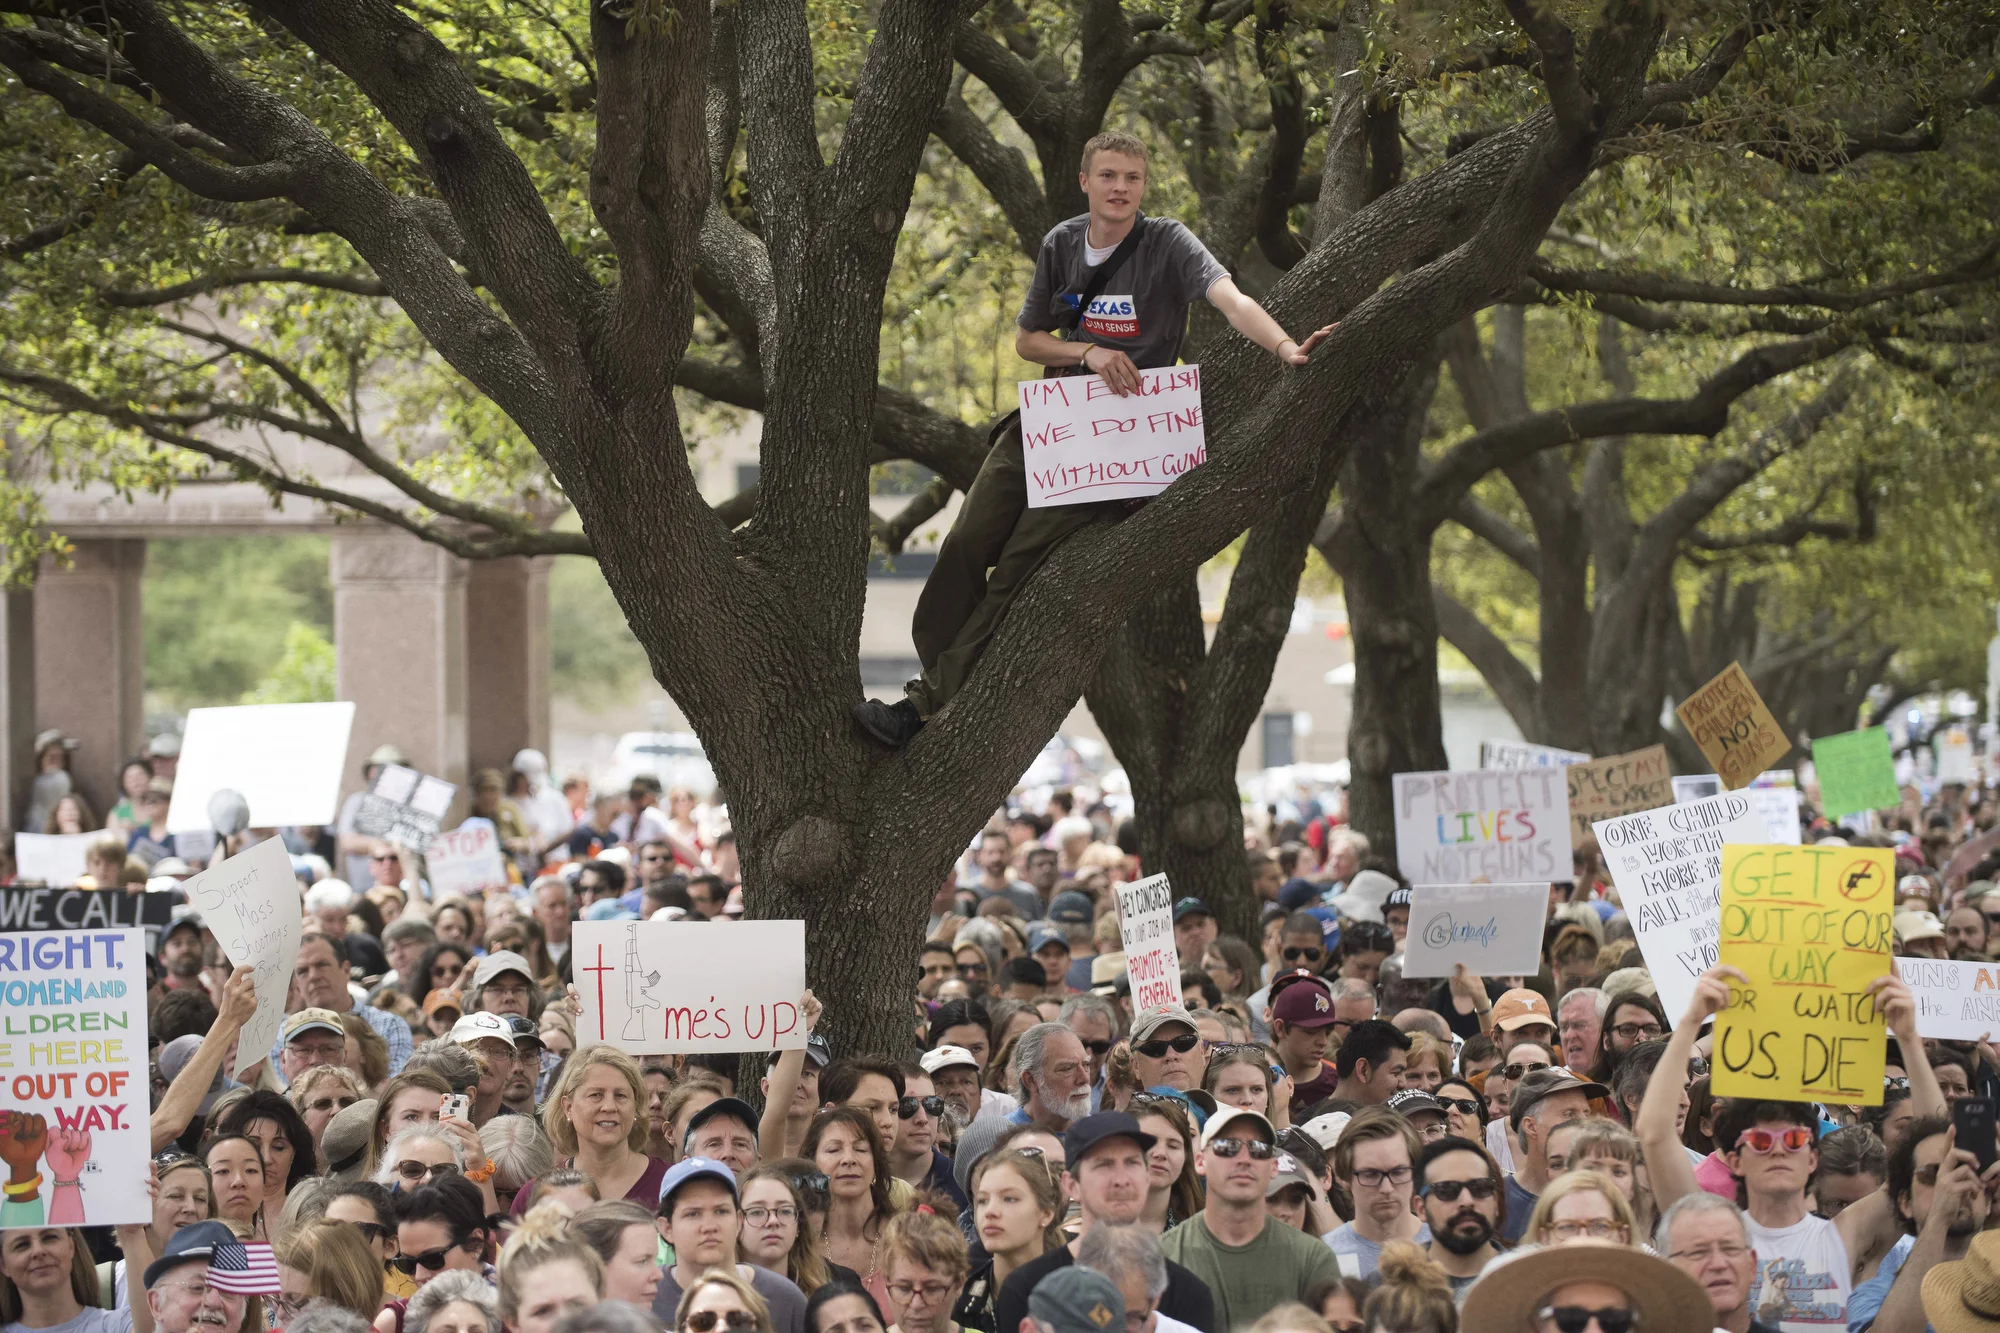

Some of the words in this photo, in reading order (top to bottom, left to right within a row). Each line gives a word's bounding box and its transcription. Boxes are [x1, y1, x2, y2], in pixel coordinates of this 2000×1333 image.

[1085, 318, 1105, 331] GUN
[1105, 322, 1137, 333] SENSE
[1089, 301, 1133, 316] EXAS
[1023, 380, 1070, 410] I'M
[1026, 422, 1076, 450] WE
[1091, 418, 1137, 437] DO
[1147, 405, 1203, 434] FINE
[1033, 456, 1159, 490] WITHOUT
[1683, 667, 1744, 725] PROTECT
[1695, 687, 1757, 745] CHILDREN
[1718, 712, 1758, 751] NOT
[1719, 721, 1775, 775] GUNS
[1635, 753, 1663, 780] MY
[1401, 768, 1558, 819] PROTECT
[1437, 810, 1536, 845] LIVES
[1605, 815, 1658, 848] ONE
[1669, 795, 1748, 833] CHILD
[427, 827, 489, 860] STOP
[1623, 855, 1640, 873] is
[1641, 829, 1724, 865] WORTH
[197, 867, 259, 911] Support
[1641, 861, 1704, 896] MORE
[1730, 849, 1836, 899] GET
[0, 888, 51, 930] WE
[55, 889, 163, 934] CALL
[234, 899, 274, 930] Mass
[1120, 890, 1136, 919] HEY
[1135, 878, 1172, 915] CONGRESS
[1639, 896, 1690, 932] ALL
[231, 923, 289, 962] Shootings
[1124, 929, 1132, 945] DO
[1148, 919, 1160, 938] JOB
[1161, 915, 1171, 934] AND
[1722, 904, 1795, 945] OUT
[1802, 909, 1840, 944] OF
[1841, 909, 1893, 952] OUR
[0, 934, 125, 972] RIGHT,
[1769, 948, 1837, 983] WAY
[0, 978, 83, 1007] OMEN
[84, 980, 127, 999] AND
[1139, 977, 1177, 1010] GENERAL
[1901, 963, 1961, 991] UNS
[1727, 988, 1757, 1012] OR
[1793, 991, 1886, 1026] WATCH
[1918, 996, 1949, 1017] the
[30, 1039, 129, 1067] HERE.
[1721, 1026, 1780, 1081] U.S.
[1801, 1034, 1869, 1092] DIE
[12, 1072, 78, 1101] OUT
[85, 1070, 129, 1098] OF
[54, 1103, 130, 1132] WAY.
